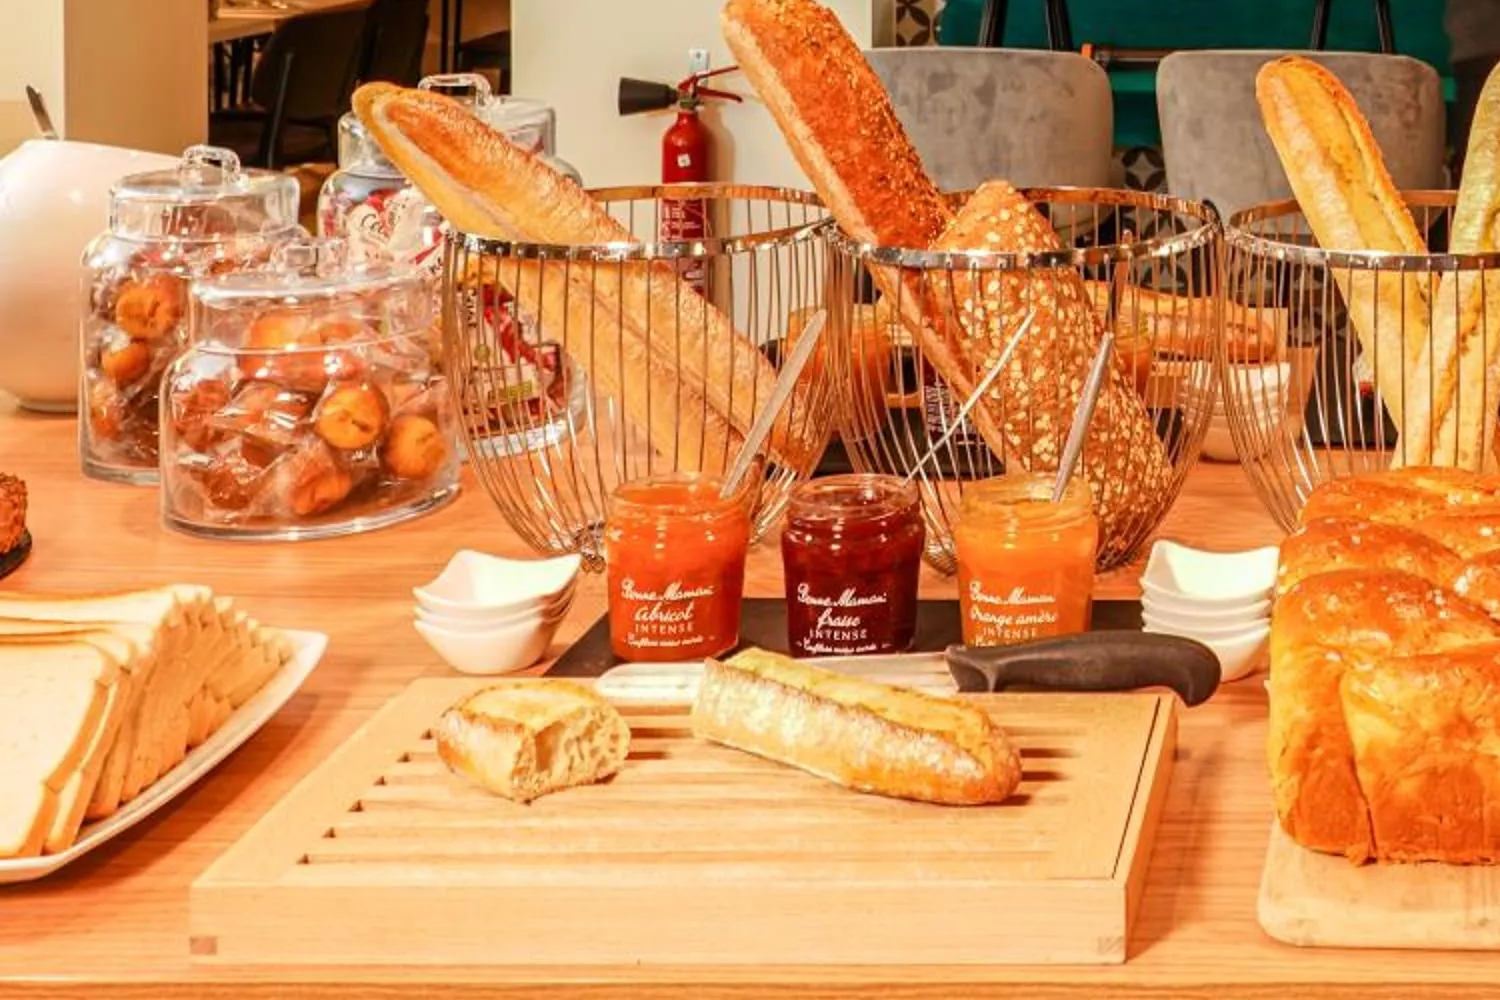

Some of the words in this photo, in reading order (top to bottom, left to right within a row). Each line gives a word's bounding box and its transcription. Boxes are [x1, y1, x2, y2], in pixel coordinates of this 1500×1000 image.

[635, 622, 694, 634] INTENSE
[983, 626, 1038, 640] INTENSE
[809, 629, 867, 641] INTENSE
